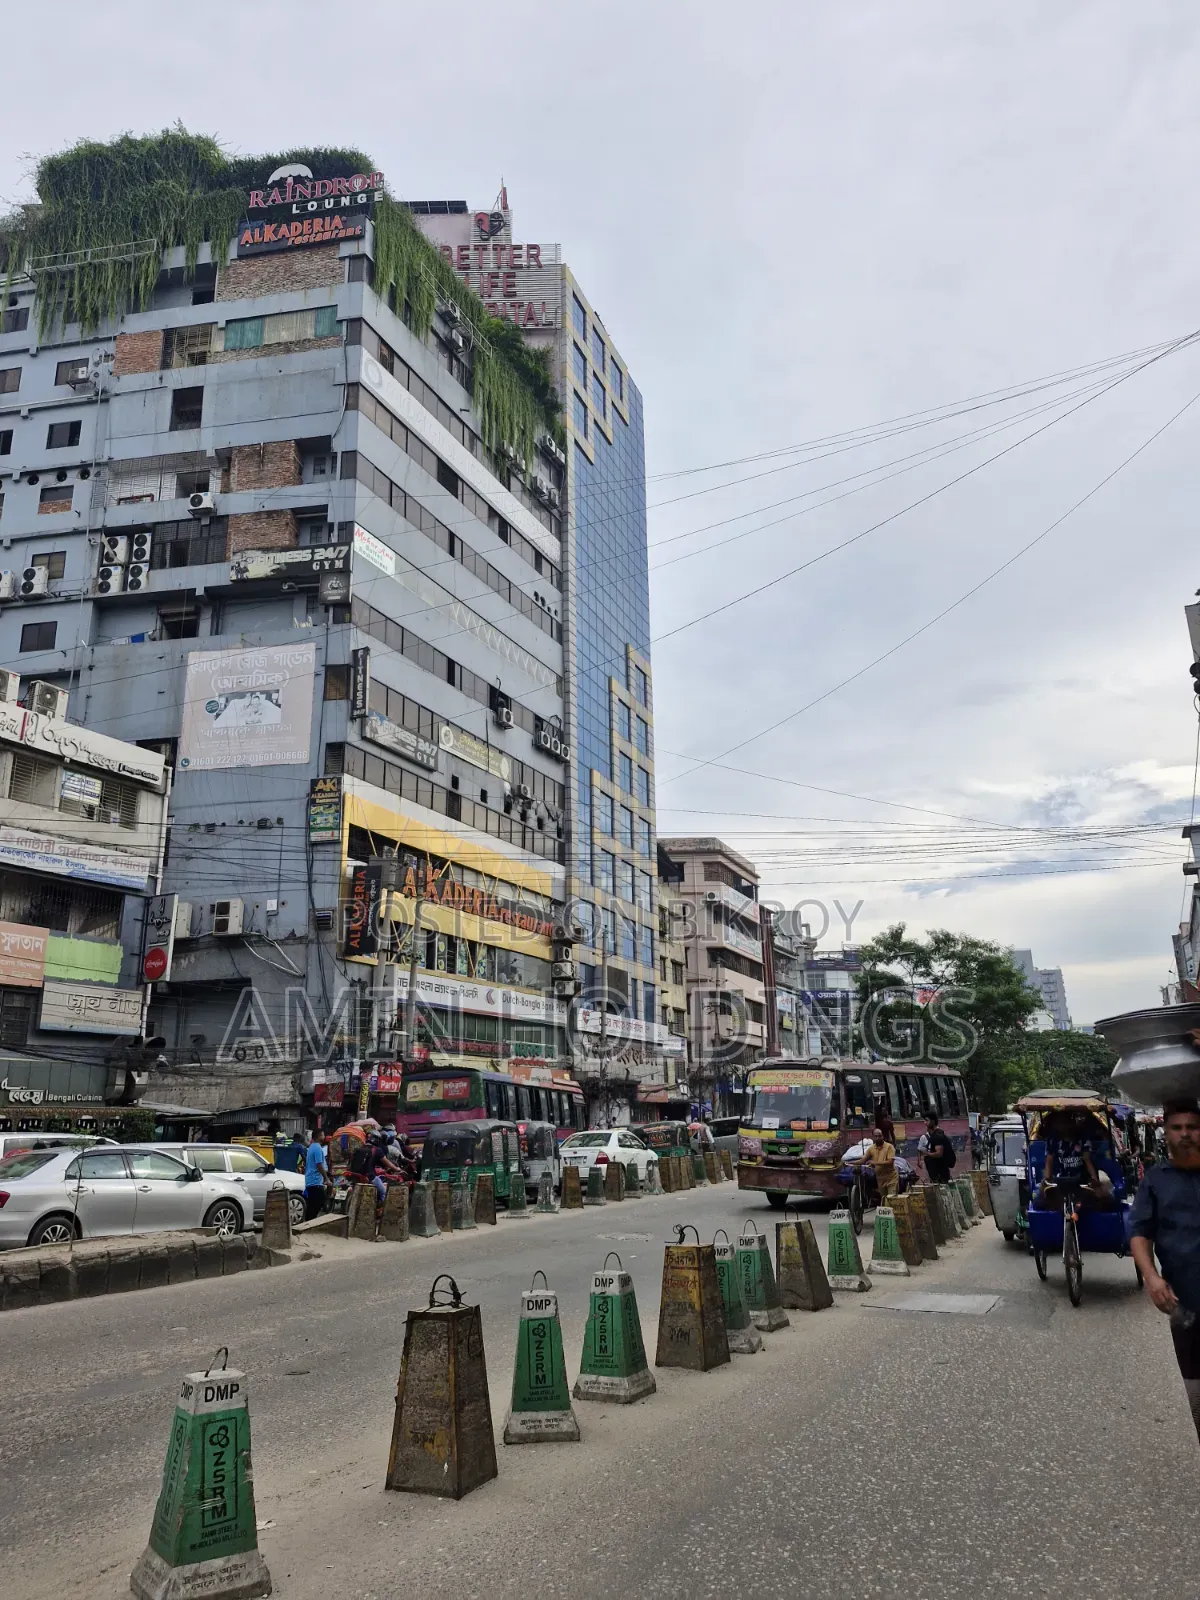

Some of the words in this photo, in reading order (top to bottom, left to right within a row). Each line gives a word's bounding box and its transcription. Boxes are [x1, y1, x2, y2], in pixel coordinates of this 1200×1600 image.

[249, 171, 384, 208] RAINDROP
[292, 191, 384, 214] LOUNGE
[240, 215, 344, 245] ALKADERIA
[288, 225, 362, 246] restaurant
[255, 549, 312, 565] FITNESS
[313, 545, 350, 561] 24/7
[312, 559, 344, 571] GYM
[356, 650, 365, 709] FITNESS
[418, 737, 439, 757] 24/7
[217, 755, 231, 765] 222
[416, 751, 436, 767] GYM
[402, 864, 500, 920] AKADERIA
[502, 991, 541, 1011] Dutch-Bangla
[380, 1080, 398, 1091] Party
[48, 1094, 76, 1103] Bengali
[76, 1093, 103, 1101] Cuisine
[740, 1238, 755, 1247] DMP
[594, 1277, 614, 1288] DMP
[620, 1275, 631, 1288] DMP
[527, 1299, 551, 1311] DMP
[599, 1314, 608, 1354] ZSRM
[535, 1339, 547, 1385] ZSRM
[180, 1381, 193, 1402] DMP
[204, 1383, 240, 1403] DMP
[212, 1451, 228, 1520] ZSRM
